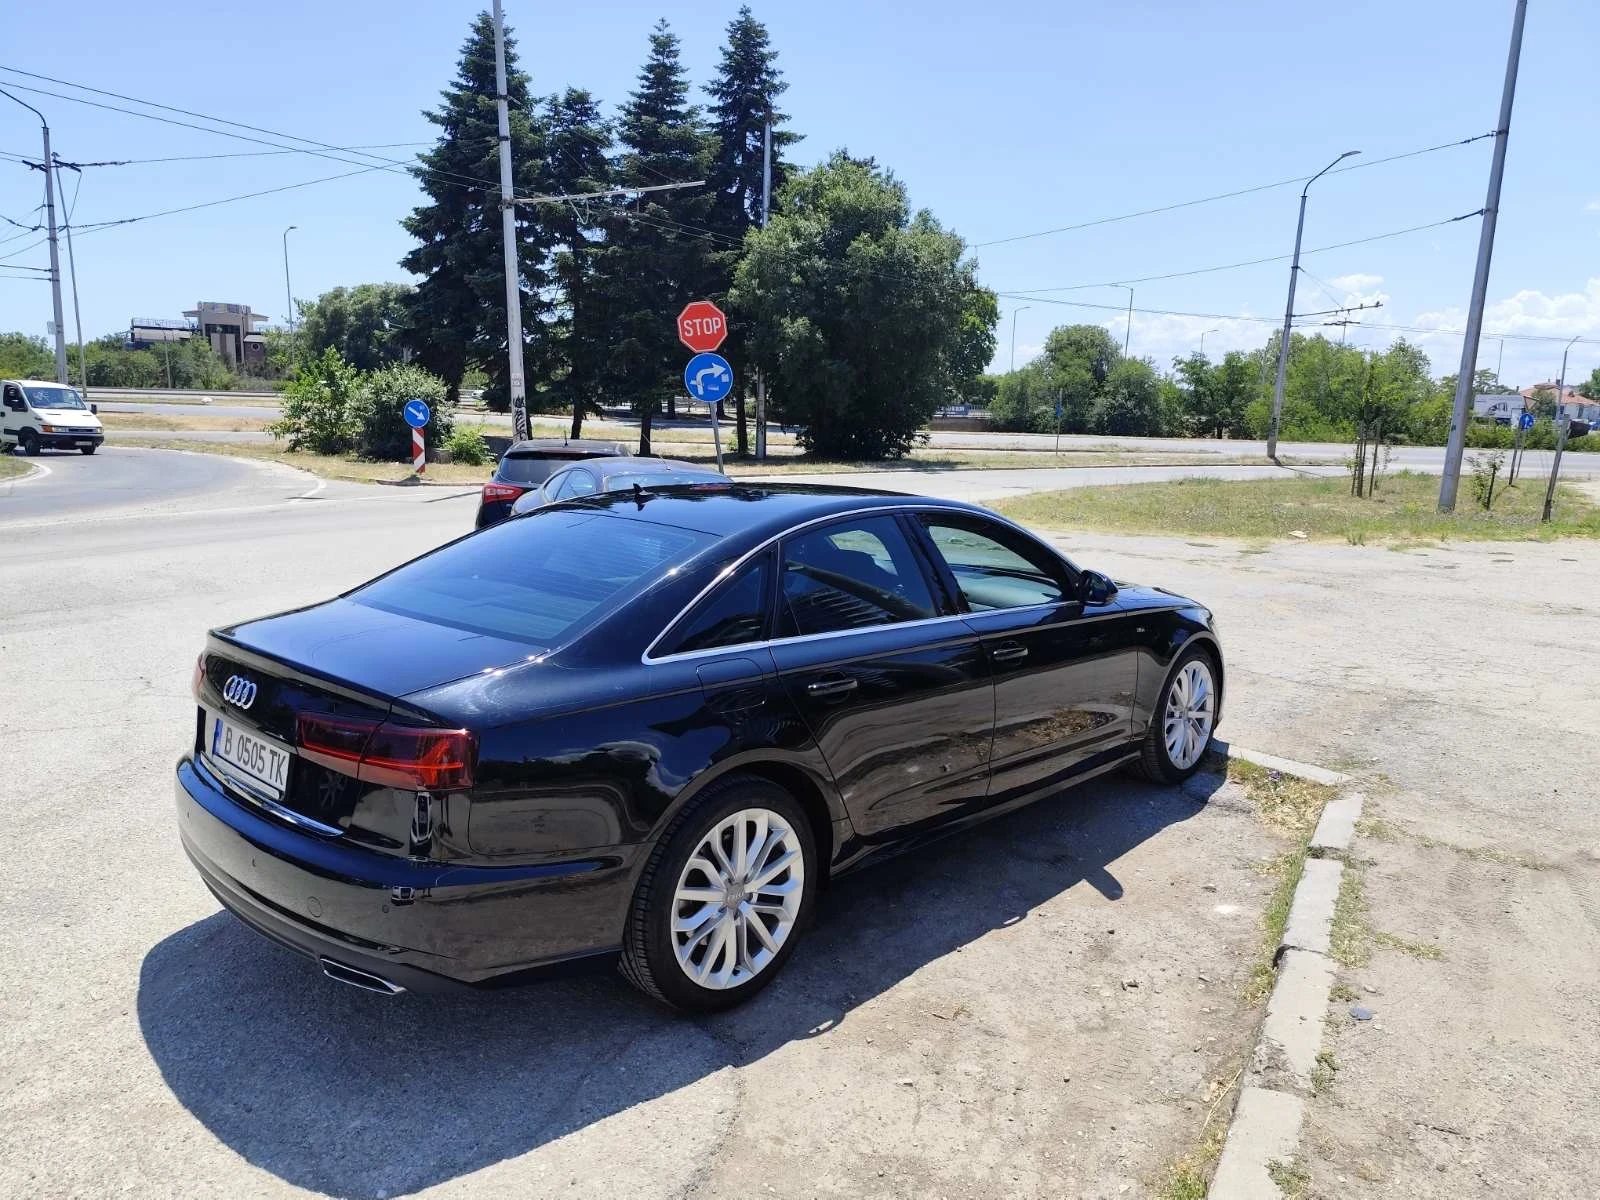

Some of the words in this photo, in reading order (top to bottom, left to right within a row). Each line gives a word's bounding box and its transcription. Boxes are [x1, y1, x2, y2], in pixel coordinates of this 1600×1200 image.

[683, 317, 722, 337] STOP
[224, 727, 233, 755] B
[236, 734, 267, 774] 0505
[269, 749, 287, 786] TK
